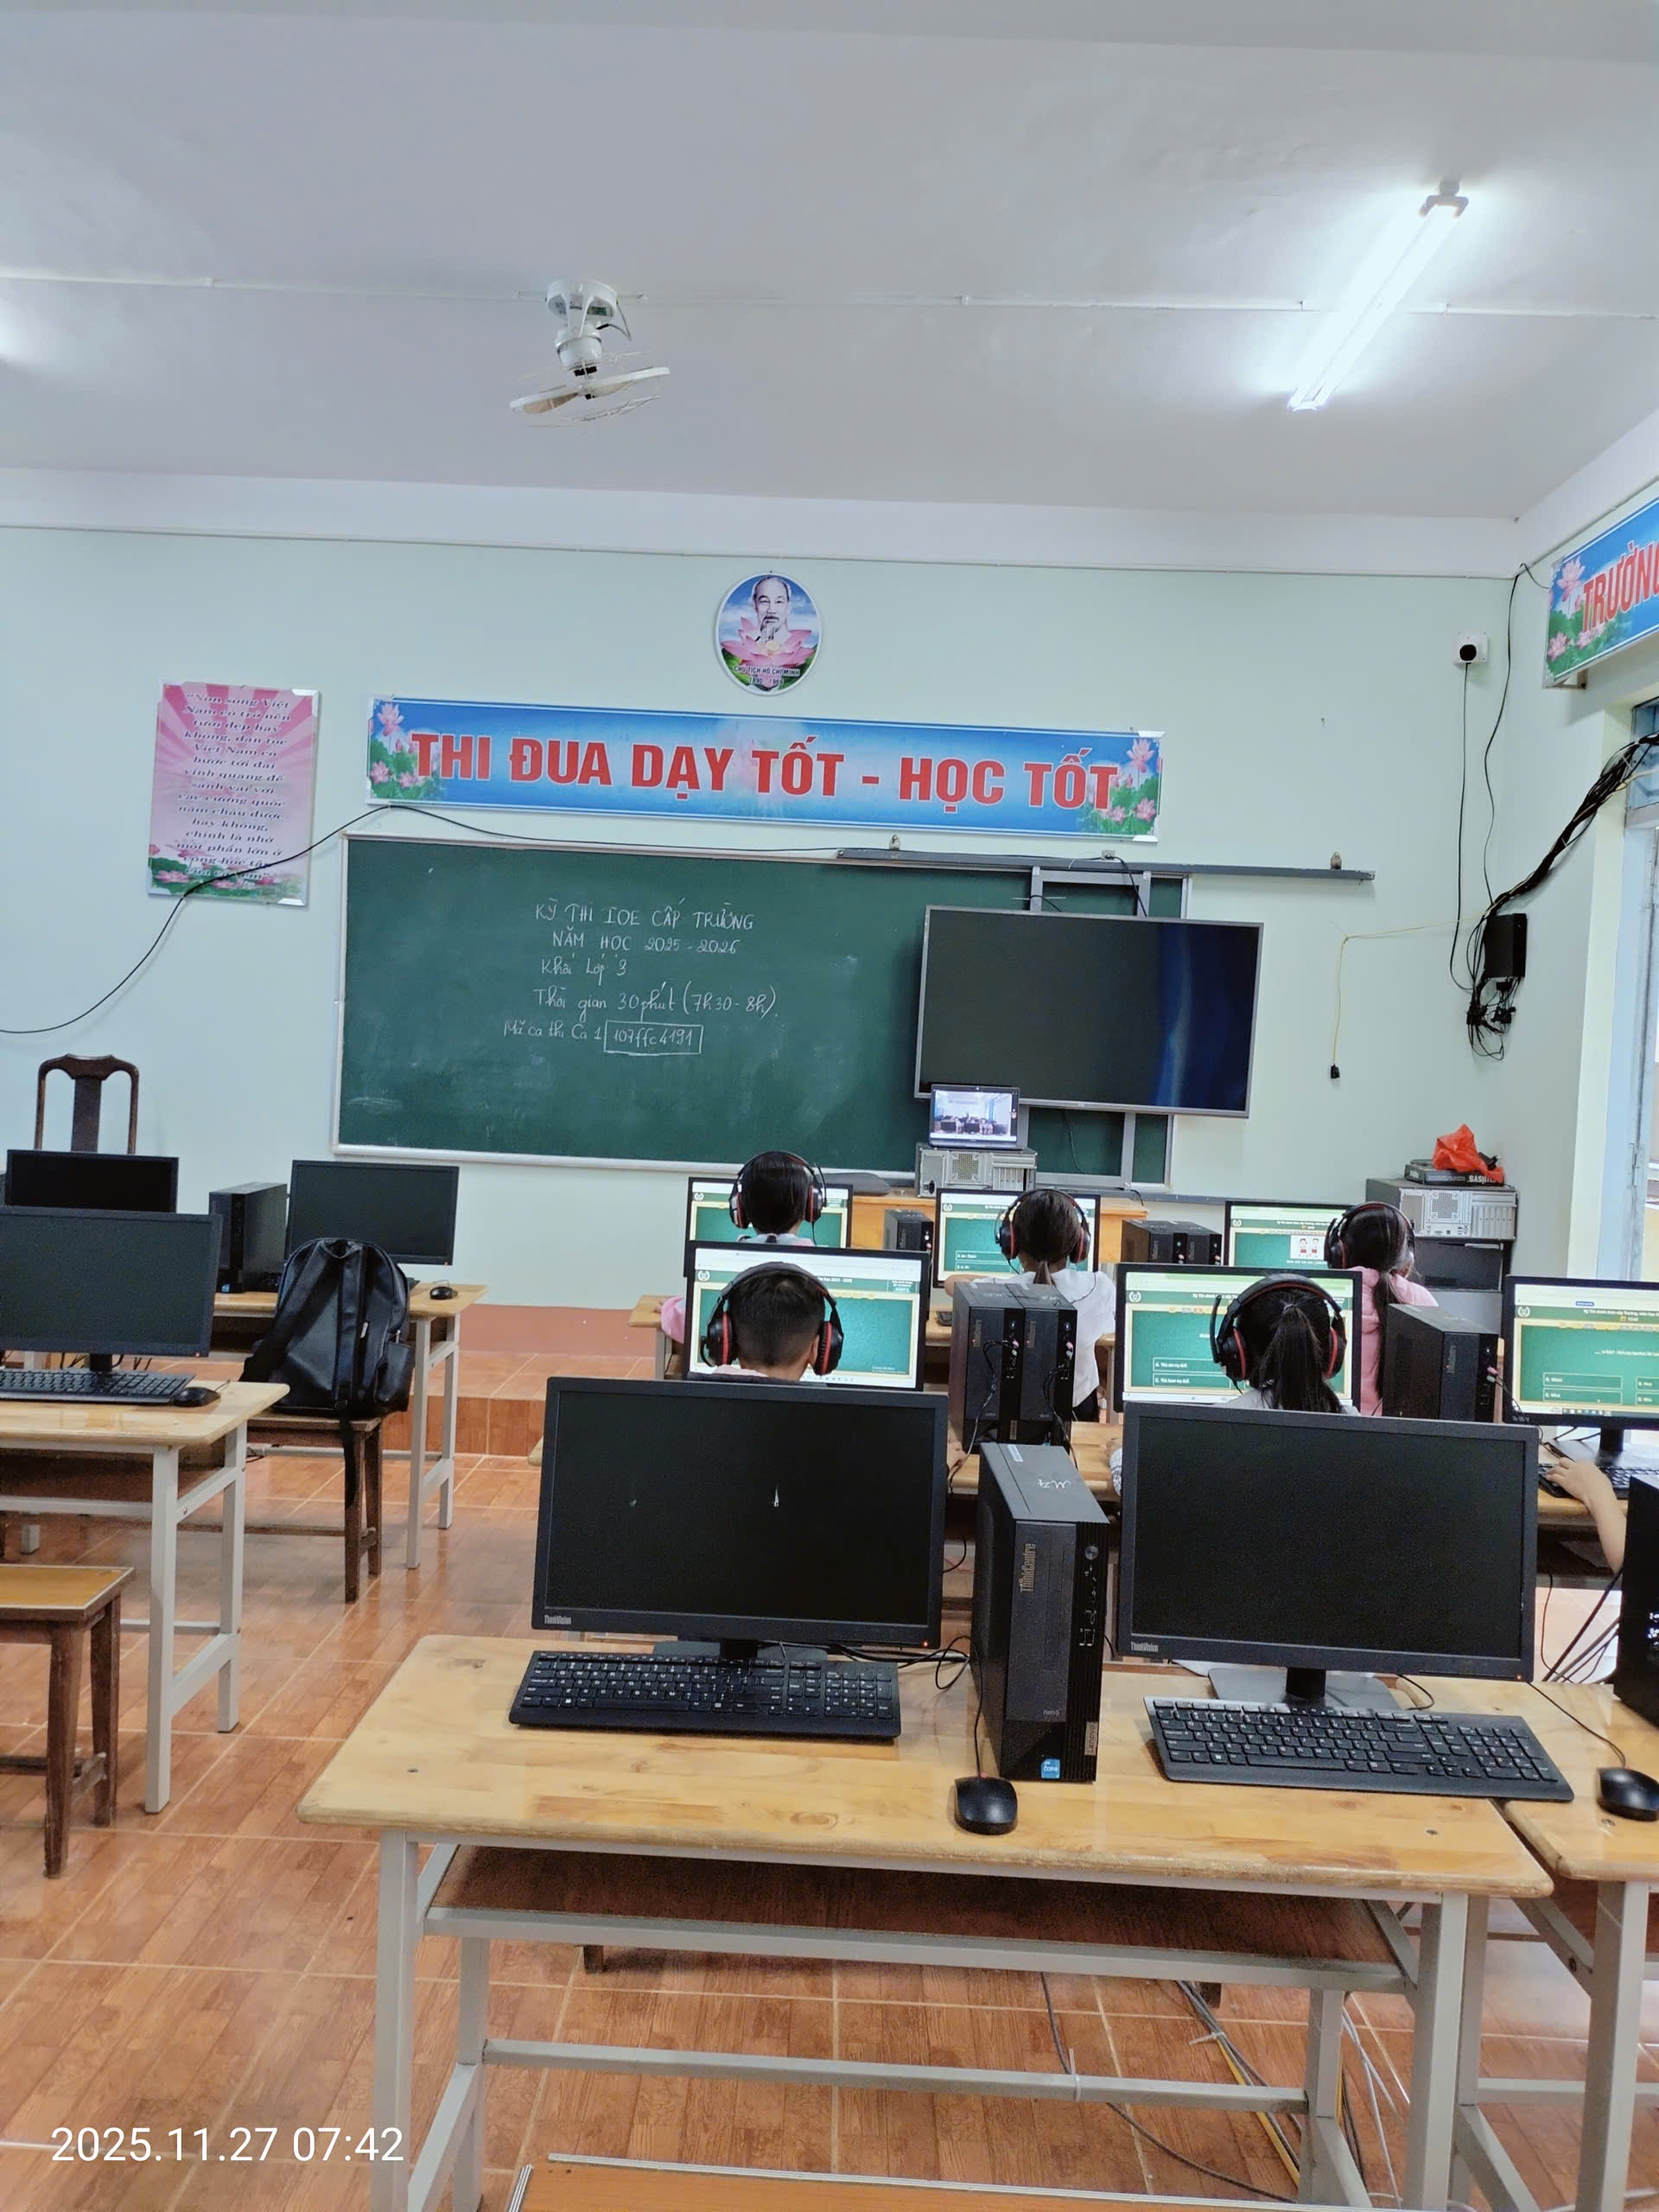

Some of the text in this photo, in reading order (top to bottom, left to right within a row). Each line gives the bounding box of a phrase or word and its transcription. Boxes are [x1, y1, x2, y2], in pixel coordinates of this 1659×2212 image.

[410, 732, 1118, 814] THI ĐUA DẠY TỐT - HỌC TỐT
[564, 901, 593, 923] THI
[601, 906, 640, 925] IOE
[652, 897, 685, 929] CẤP
[553, 925, 584, 948] NĂM
[645, 937, 681, 952] 2025
[696, 939, 741, 954] 2026
[616, 958, 626, 976] 3
[578, 995, 607, 1023] gian
[528, 1026, 543, 1036] ca
[549, 1020, 564, 1038] thi
[571, 1023, 588, 1039] Ca
[594, 1027, 602, 1039] 1
[1019, 1542, 1037, 1593] ThinkCentre
